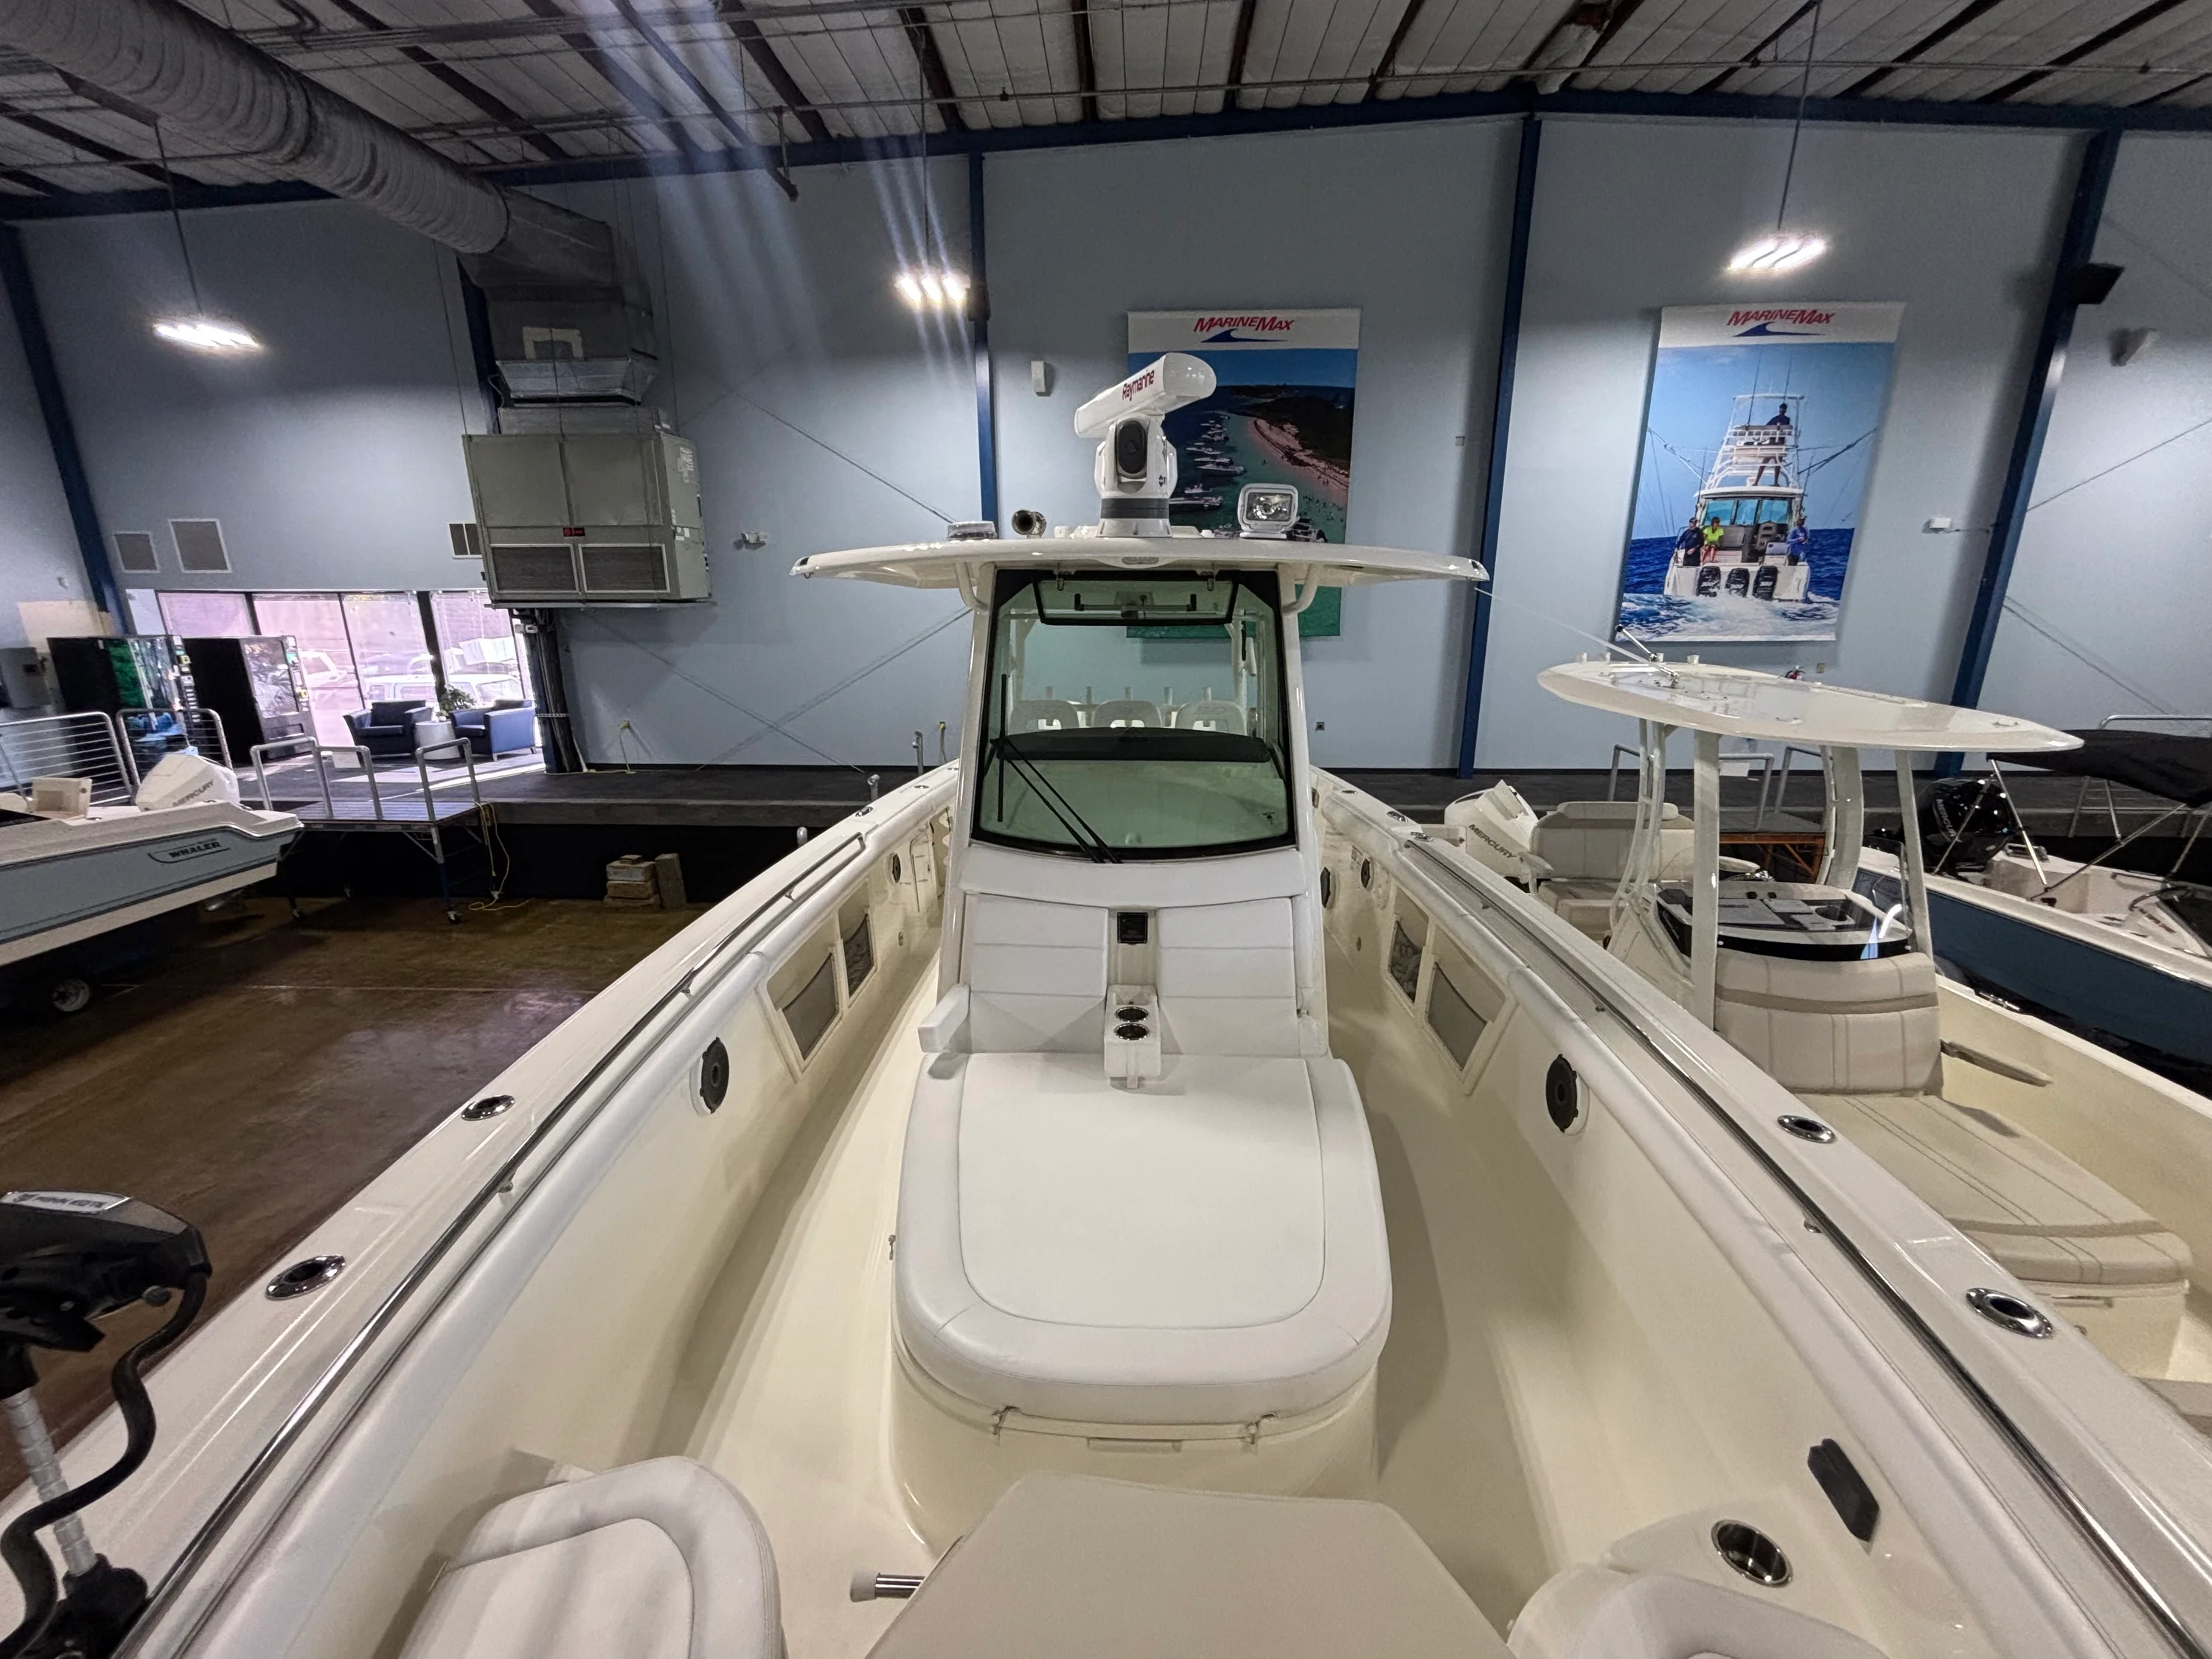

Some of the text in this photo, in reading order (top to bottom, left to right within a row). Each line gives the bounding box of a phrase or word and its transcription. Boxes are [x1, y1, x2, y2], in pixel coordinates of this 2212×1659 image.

[1122, 369, 1155, 402] Raymarine
[168, 841, 221, 859] WHALER
[1469, 824, 1517, 858] MERCURY
